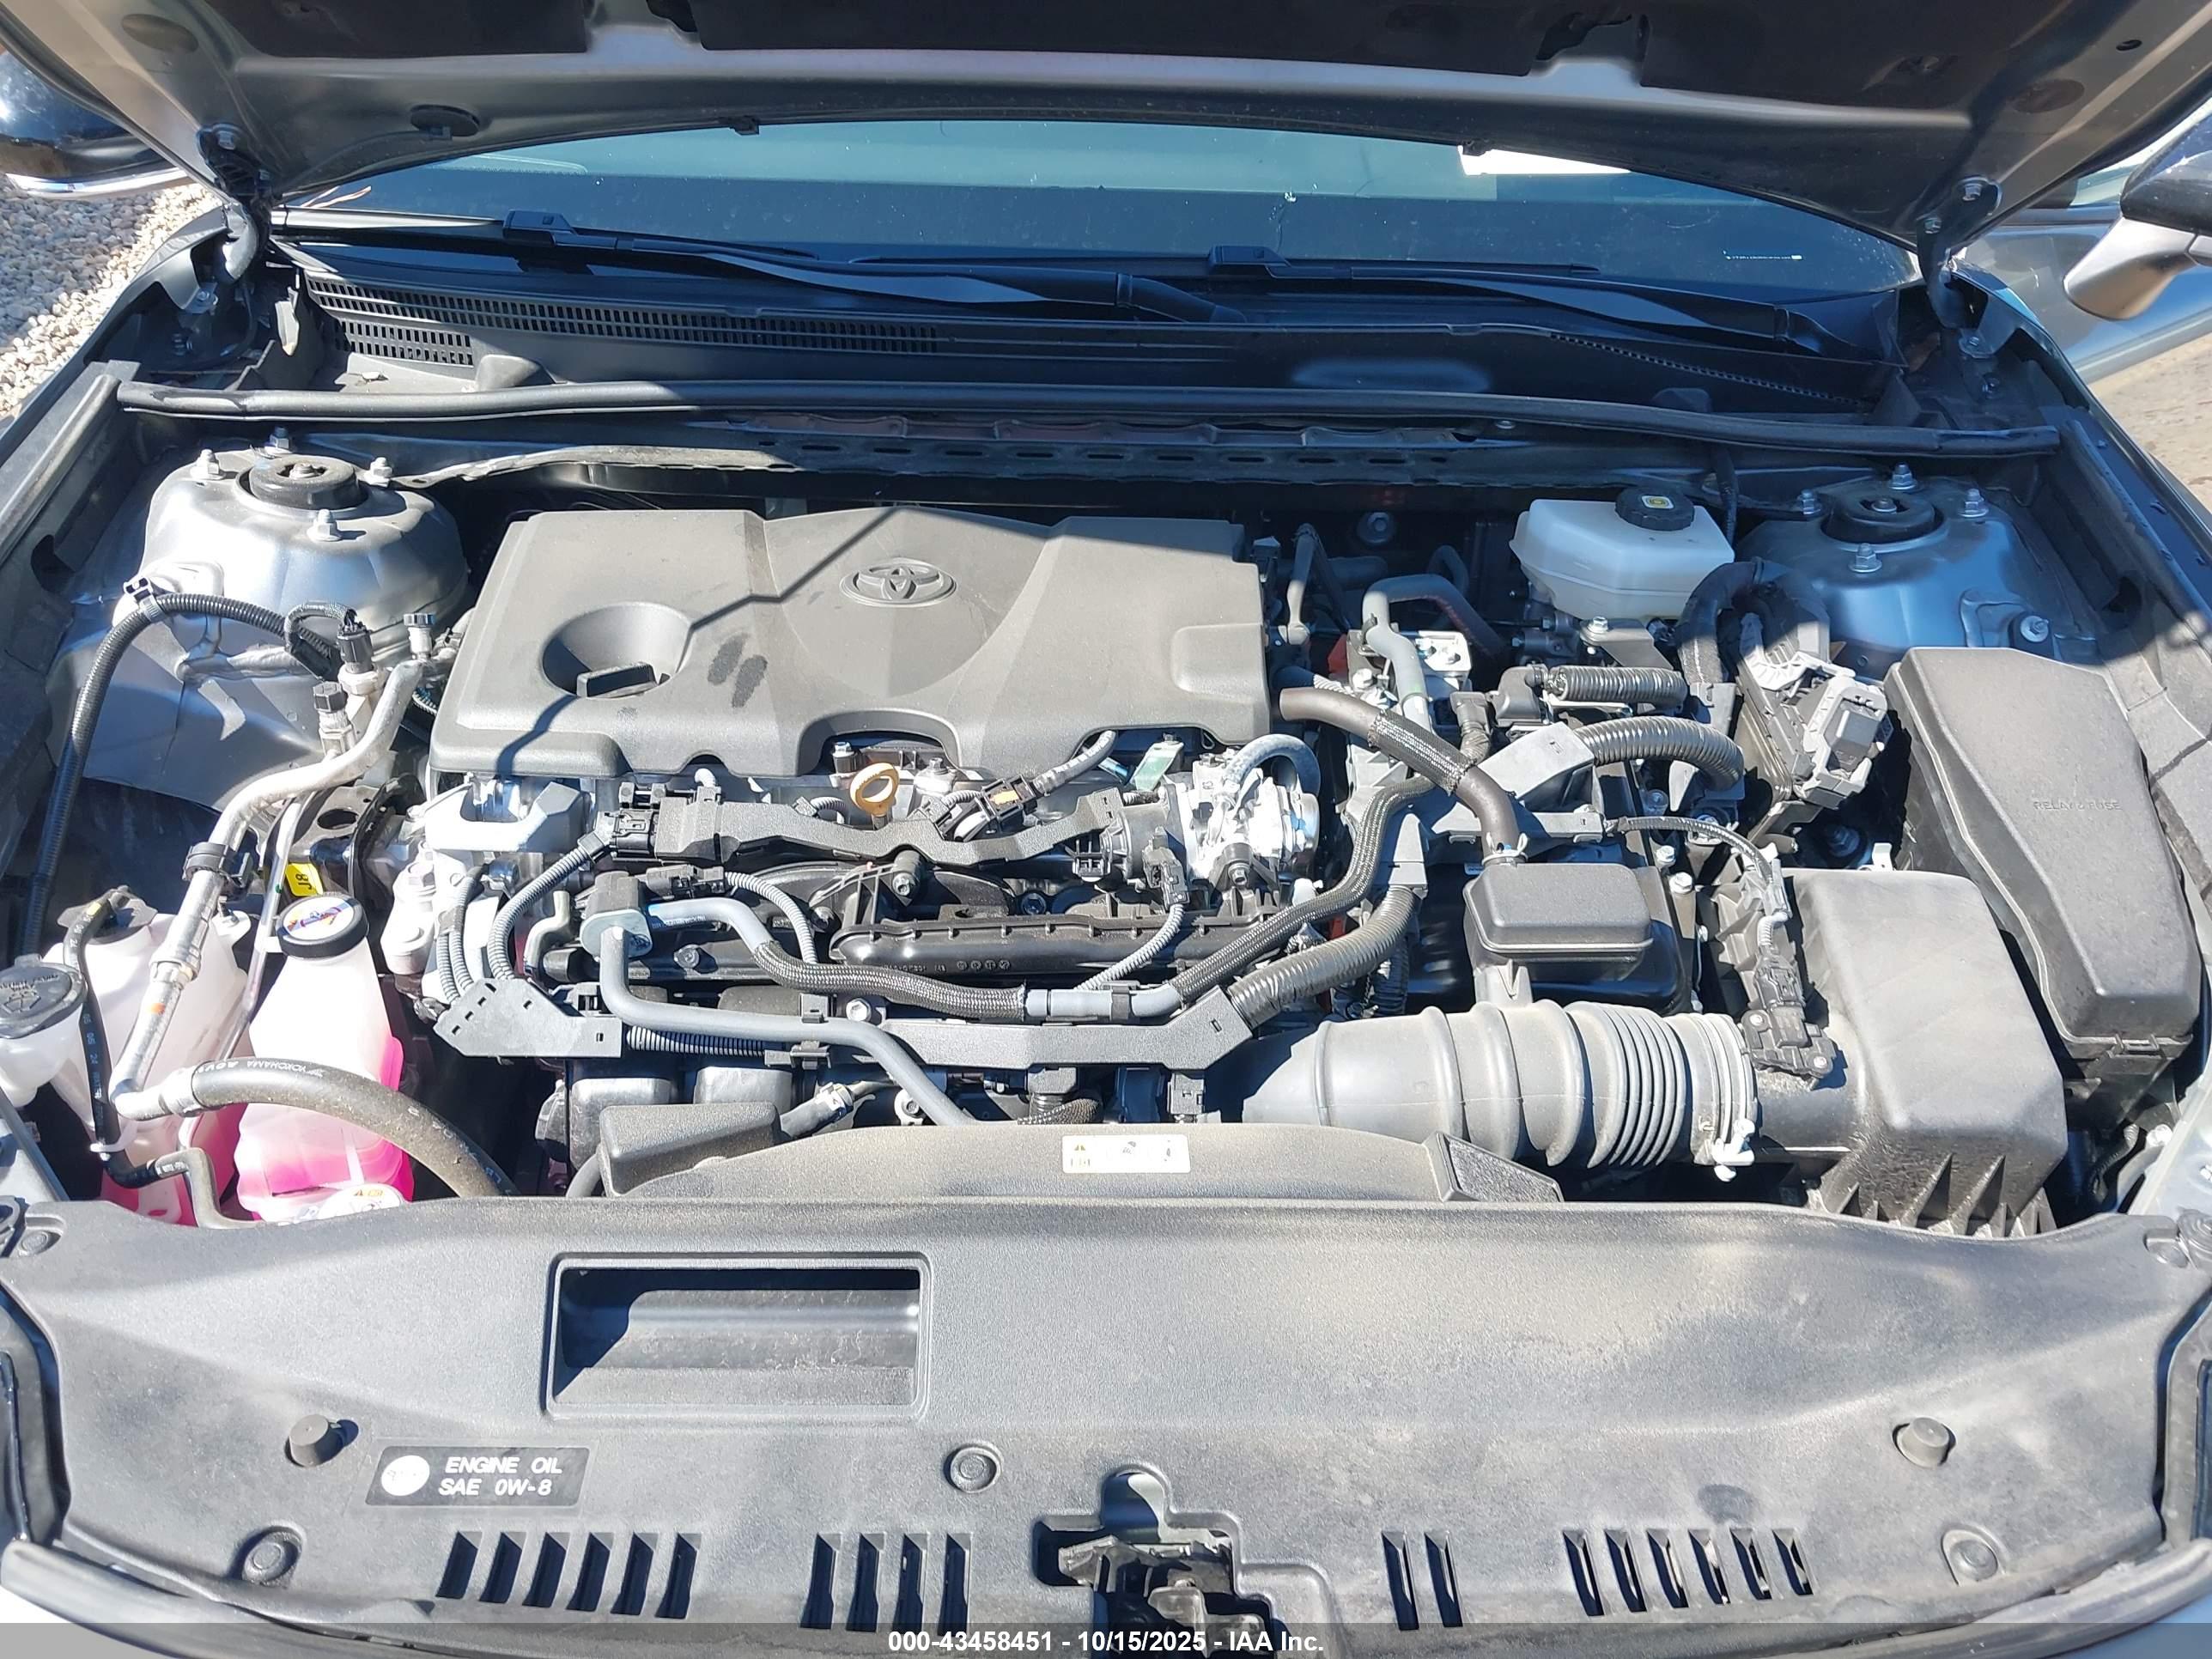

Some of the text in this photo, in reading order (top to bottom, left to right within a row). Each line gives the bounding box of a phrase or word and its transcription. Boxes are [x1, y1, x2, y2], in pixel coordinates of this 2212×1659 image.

[246, 1060, 307, 1073] YOKOHAMA
[445, 1456, 563, 1474] ENGINE OIL
[438, 1477, 552, 1496] SAE 0W-8
